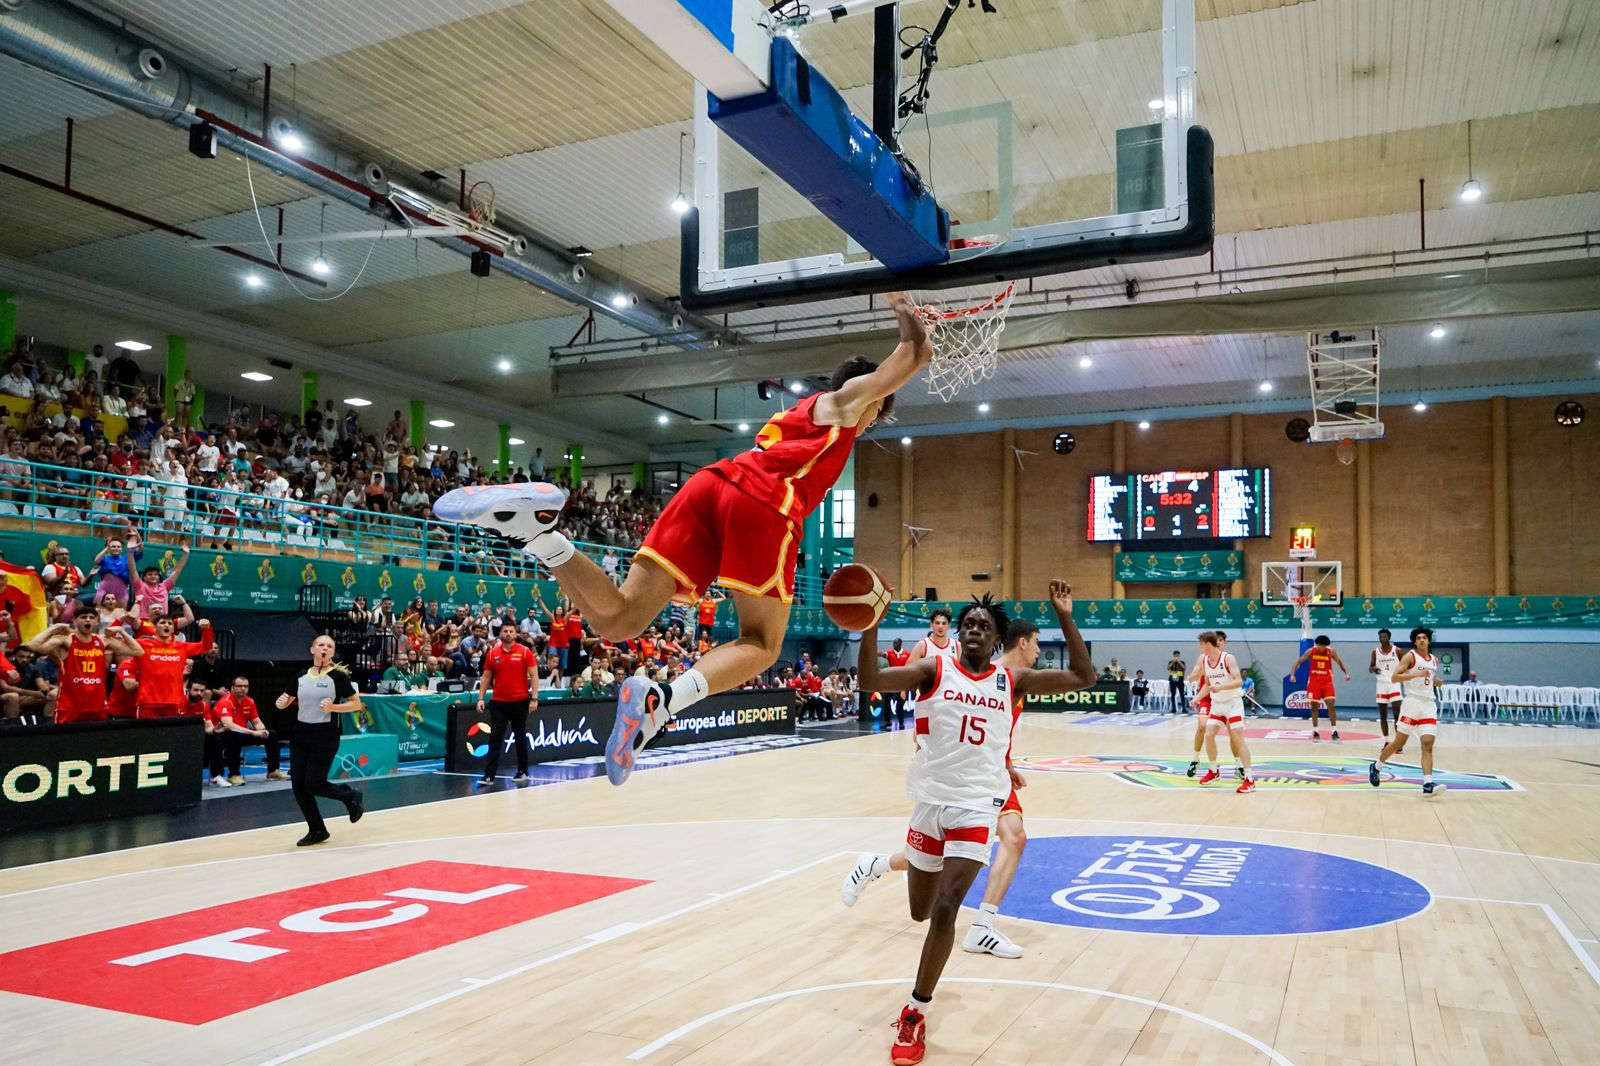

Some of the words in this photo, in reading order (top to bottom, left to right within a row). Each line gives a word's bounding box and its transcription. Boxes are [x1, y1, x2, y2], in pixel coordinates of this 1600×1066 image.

[1150, 481, 1168, 493] 12
[1188, 480, 1199, 492] 4
[1160, 493, 1192, 505] 5:32
[1145, 516, 1155, 527] 0
[1172, 515, 1180, 526] 1
[1198, 514, 1208, 525] 2
[1293, 536, 1311, 549] 20
[81, 661, 96, 673] 10
[943, 689, 1005, 712] CANADA
[1026, 691, 1117, 704] DEPORTE
[1287, 699, 1324, 709] Gantn
[718, 709, 736, 728] del
[737, 705, 788, 725] DEPORTE
[959, 714, 987, 746] 15
[398, 741, 409, 751] U17
[2, 752, 170, 803] ORTE
[1180, 847, 1252, 887] WANDA
[107, 883, 529, 967] TCL
